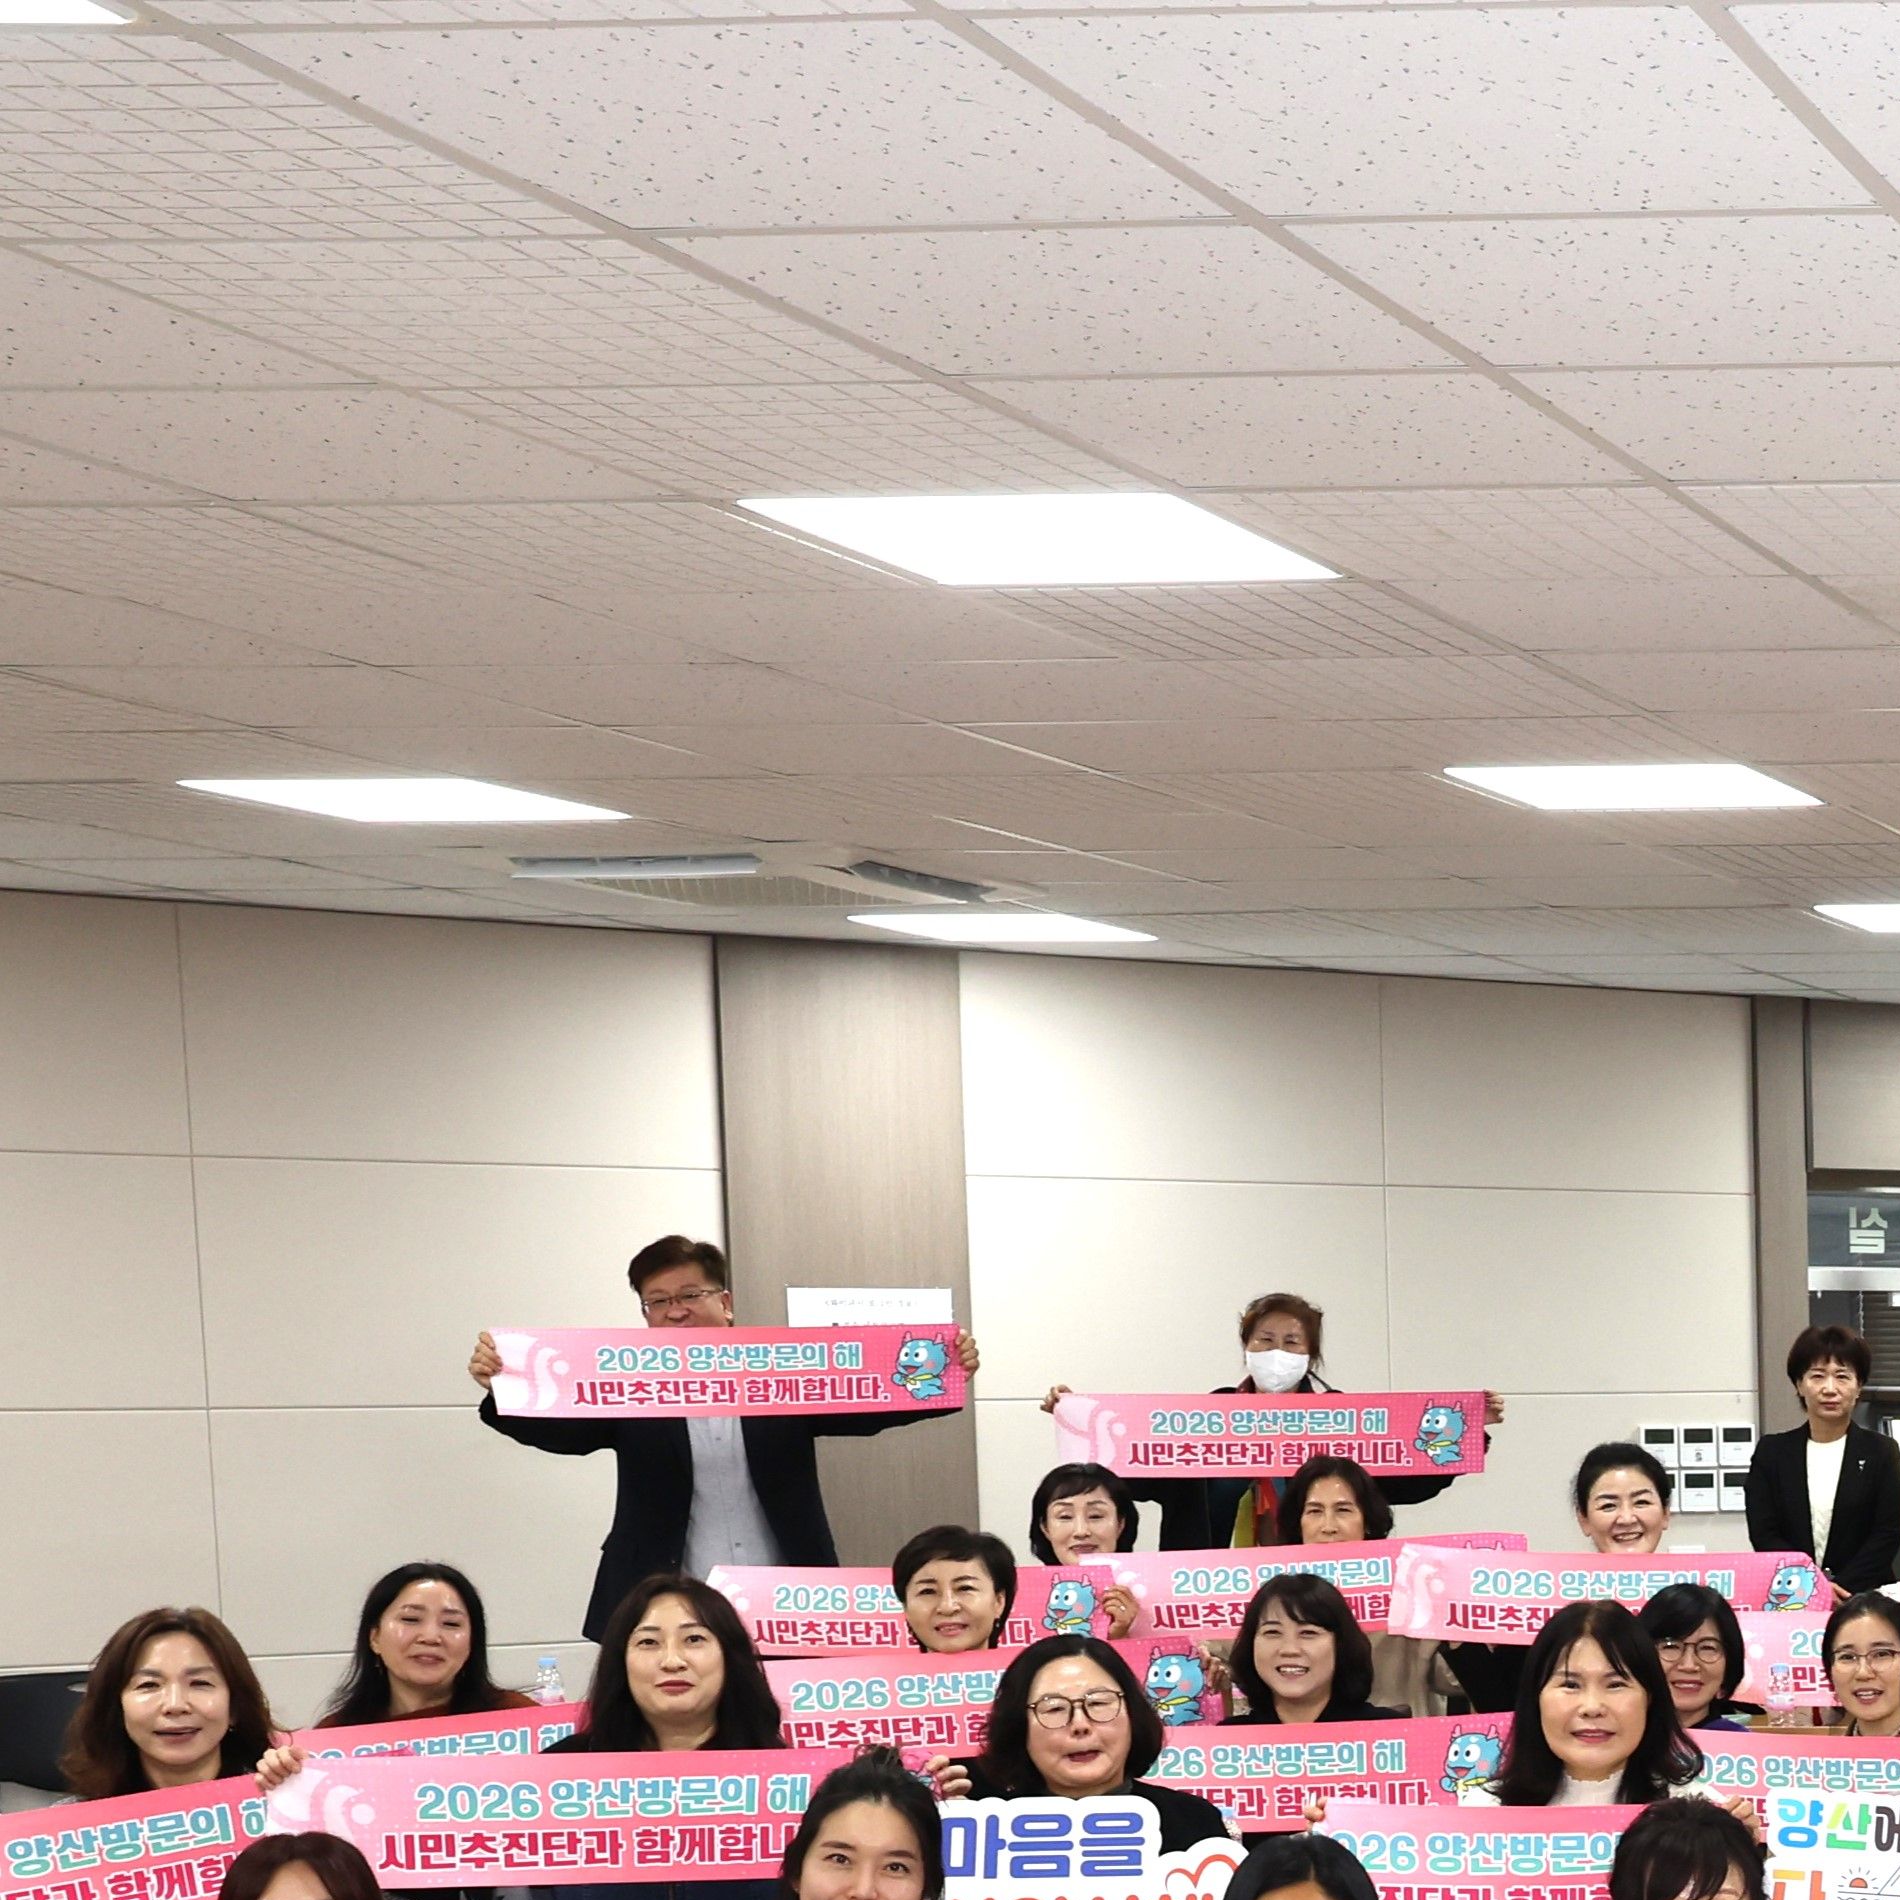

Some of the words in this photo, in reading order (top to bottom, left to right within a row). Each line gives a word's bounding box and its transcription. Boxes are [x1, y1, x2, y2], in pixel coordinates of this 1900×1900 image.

[597, 1345, 681, 1373] 2026
[687, 1342, 827, 1371] 양산방문의
[833, 1342, 861, 1369] 해
[574, 1378, 736, 1407] 시민추진단과
[745, 1373, 891, 1402] 함께합니다.
[1151, 1411, 1224, 1435] 2026
[1230, 1409, 1356, 1435] 양산방문의
[1363, 1408, 1387, 1433] 해
[1127, 1442, 1274, 1467] 시민추진단과
[1173, 1569, 1249, 1594] 2026
[1472, 1570, 1552, 1597] 2026
[775, 1586, 846, 1611] 2026
[754, 1620, 900, 1645] 시민추진단과
[791, 1680, 891, 1713] 2026
[1212, 1741, 1366, 1777] 양산방문의
[1373, 1739, 1404, 1774] 해
[417, 1784, 538, 1821] 2026
[549, 1777, 759, 1818] 양산방문의
[767, 1774, 810, 1811] 해
[8, 1806, 232, 1874] 양산방문의
[378, 1833, 622, 1871] 시민추진단과
[944, 1811, 1143, 1878] 마음을
